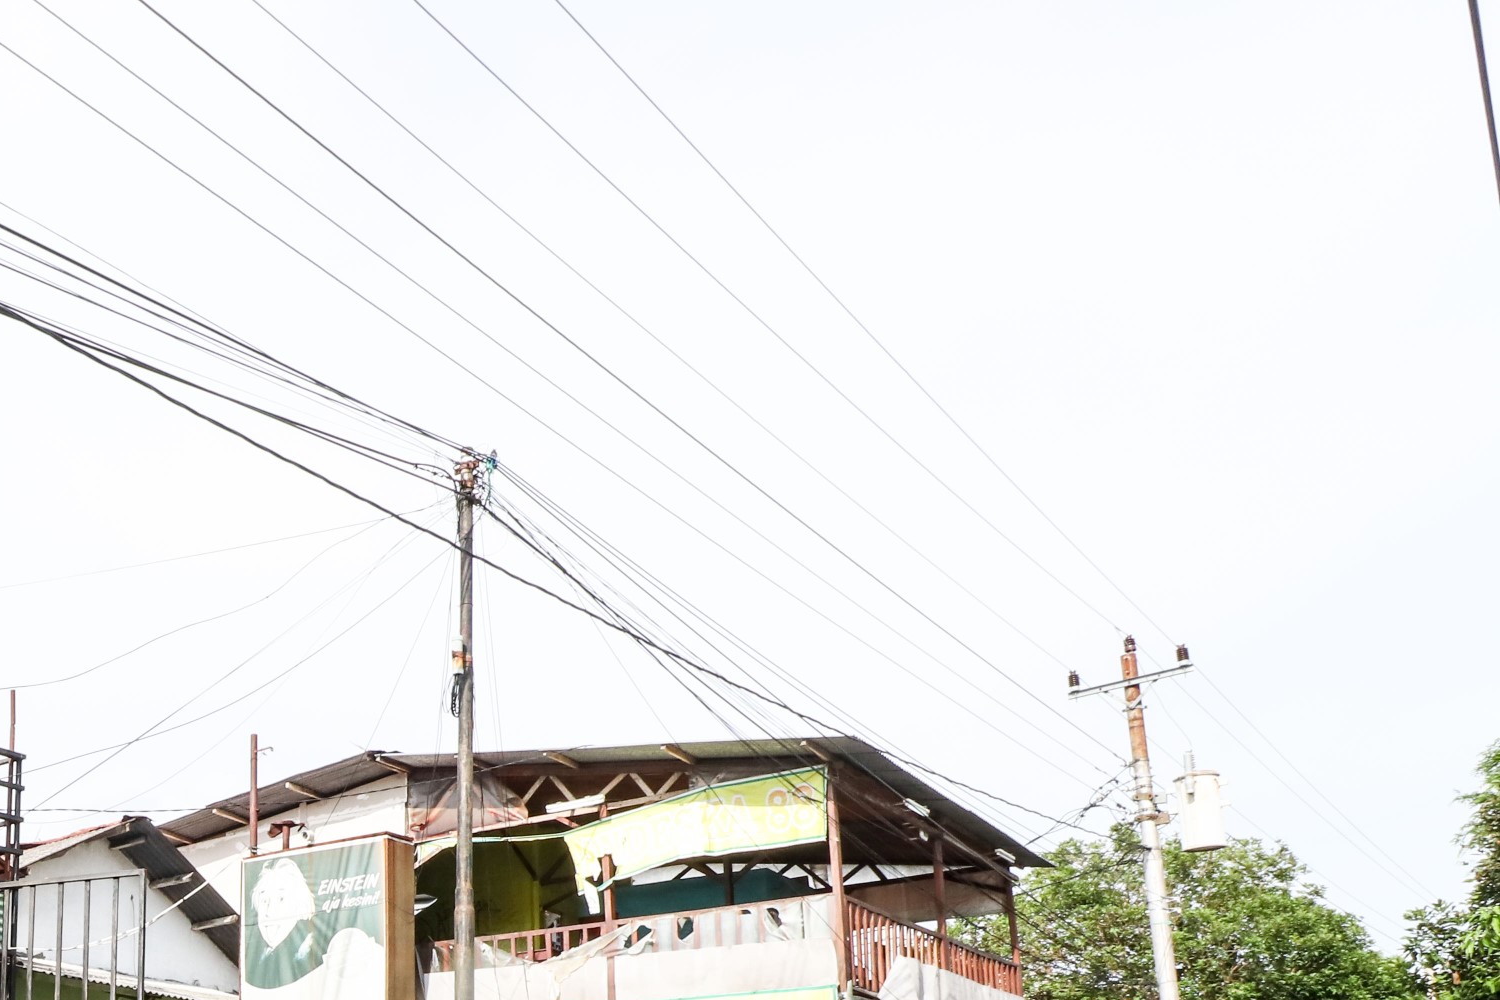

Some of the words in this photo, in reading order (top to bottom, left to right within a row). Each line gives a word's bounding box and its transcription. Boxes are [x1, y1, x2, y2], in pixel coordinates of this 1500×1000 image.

[765, 781, 818, 833] 88
[318, 872, 380, 896] EINSTEIN
[322, 896, 341, 914] aja
